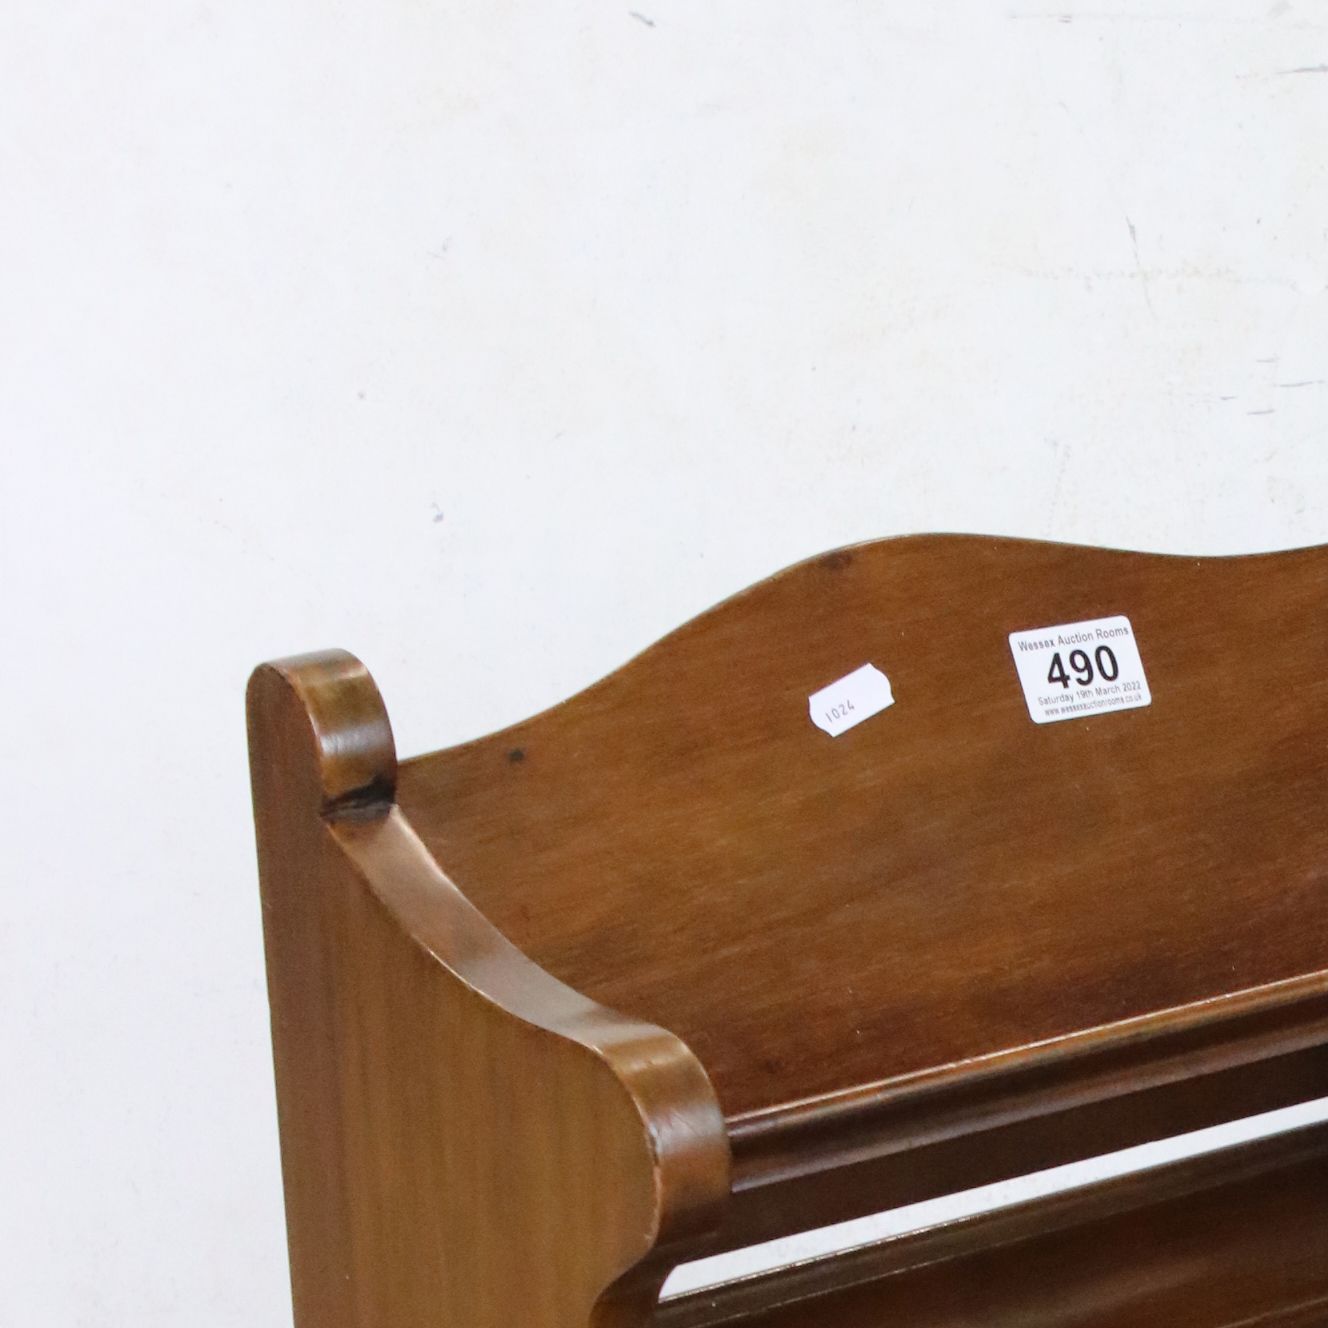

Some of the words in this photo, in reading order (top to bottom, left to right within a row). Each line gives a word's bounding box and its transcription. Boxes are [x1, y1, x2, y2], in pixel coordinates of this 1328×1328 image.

[1018, 640, 1056, 652] Wessex
[1058, 633, 1094, 646] Auction
[1095, 626, 1129, 639] Rooms
[1047, 645, 1119, 688] 490
[1037, 693, 1074, 706] Saturday
[1076, 690, 1094, 699] 19th
[1095, 685, 1120, 697] March
[1122, 681, 1141, 691] 2022
[825, 699, 855, 723] 1024
